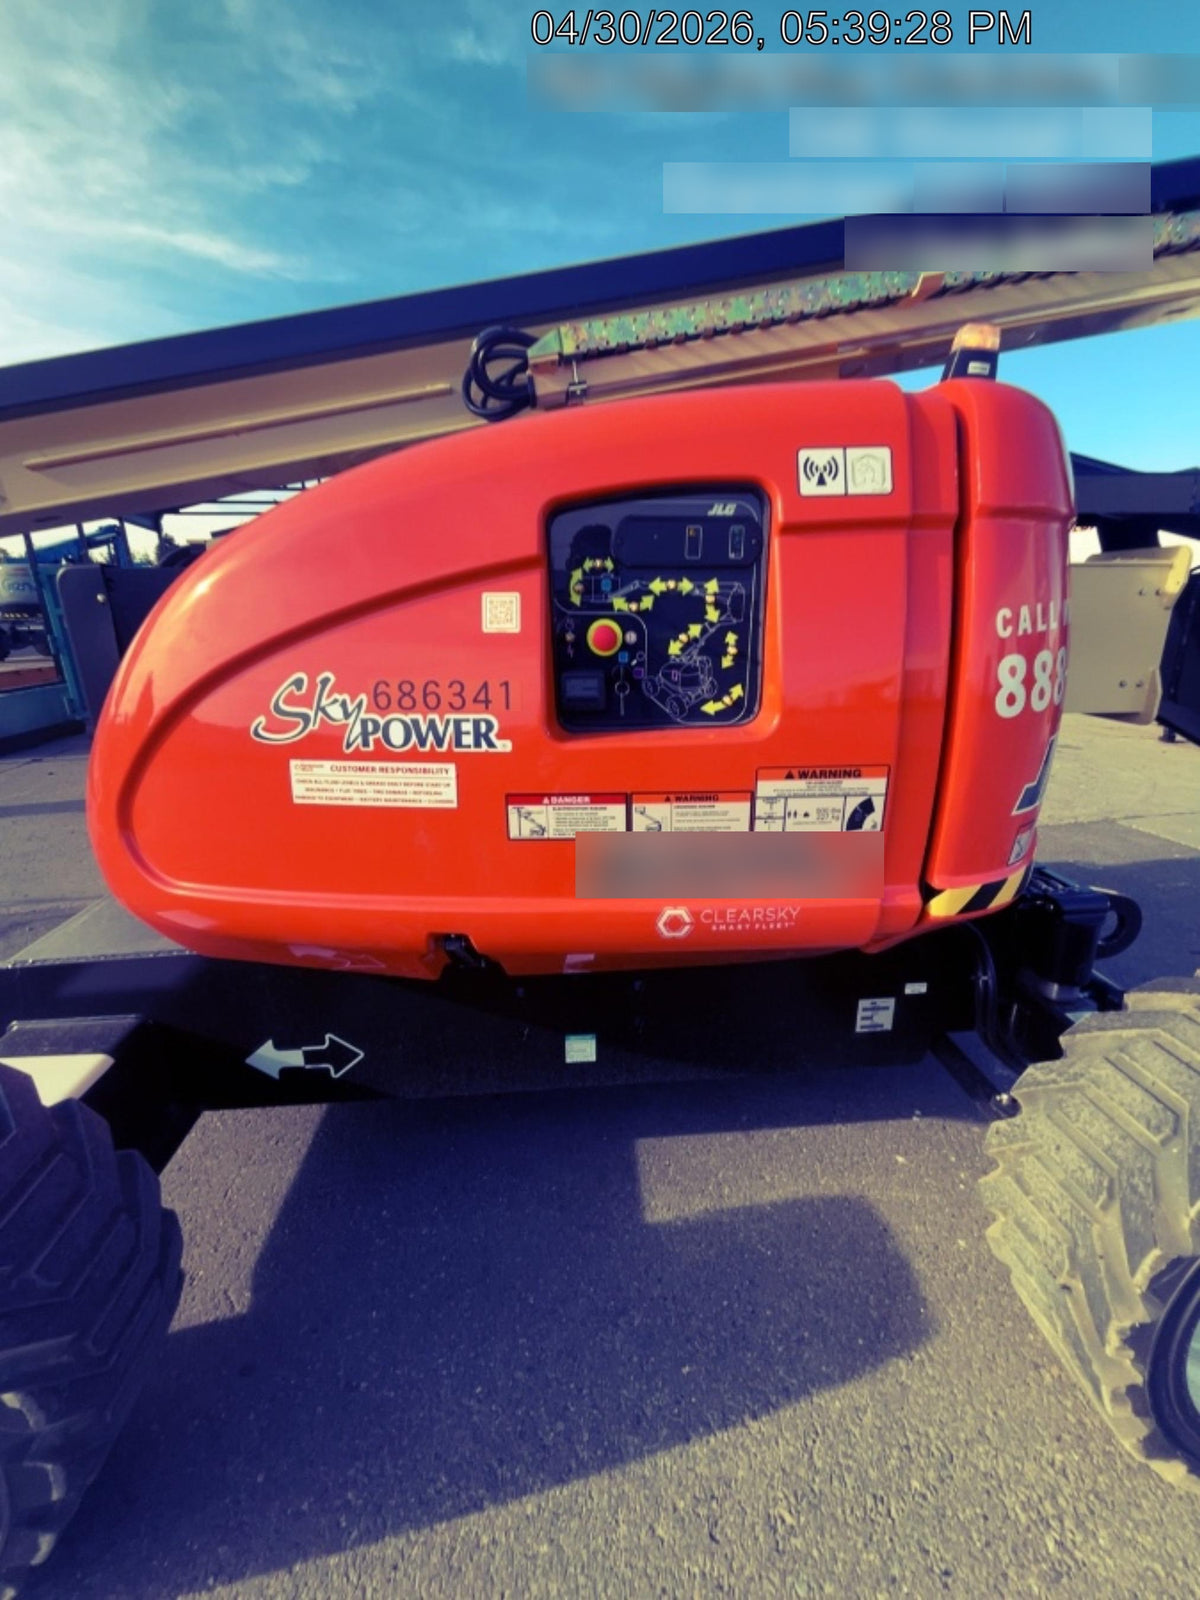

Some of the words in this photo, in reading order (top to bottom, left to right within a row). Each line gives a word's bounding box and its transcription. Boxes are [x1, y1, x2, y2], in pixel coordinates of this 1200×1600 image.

[707, 503, 737, 517] JLG
[995, 601, 1059, 638] CALL
[372, 679, 511, 711] 686341
[251, 673, 368, 752] Sky
[358, 716, 499, 750] POWER
[330, 764, 377, 774] CUSTOMER
[378, 765, 450, 776] RESPONSIBILITY
[798, 768, 862, 780] WARNING
[550, 795, 591, 805] DANGER
[674, 794, 720, 803] WARNING
[700, 906, 801, 924] CLEARSKY
